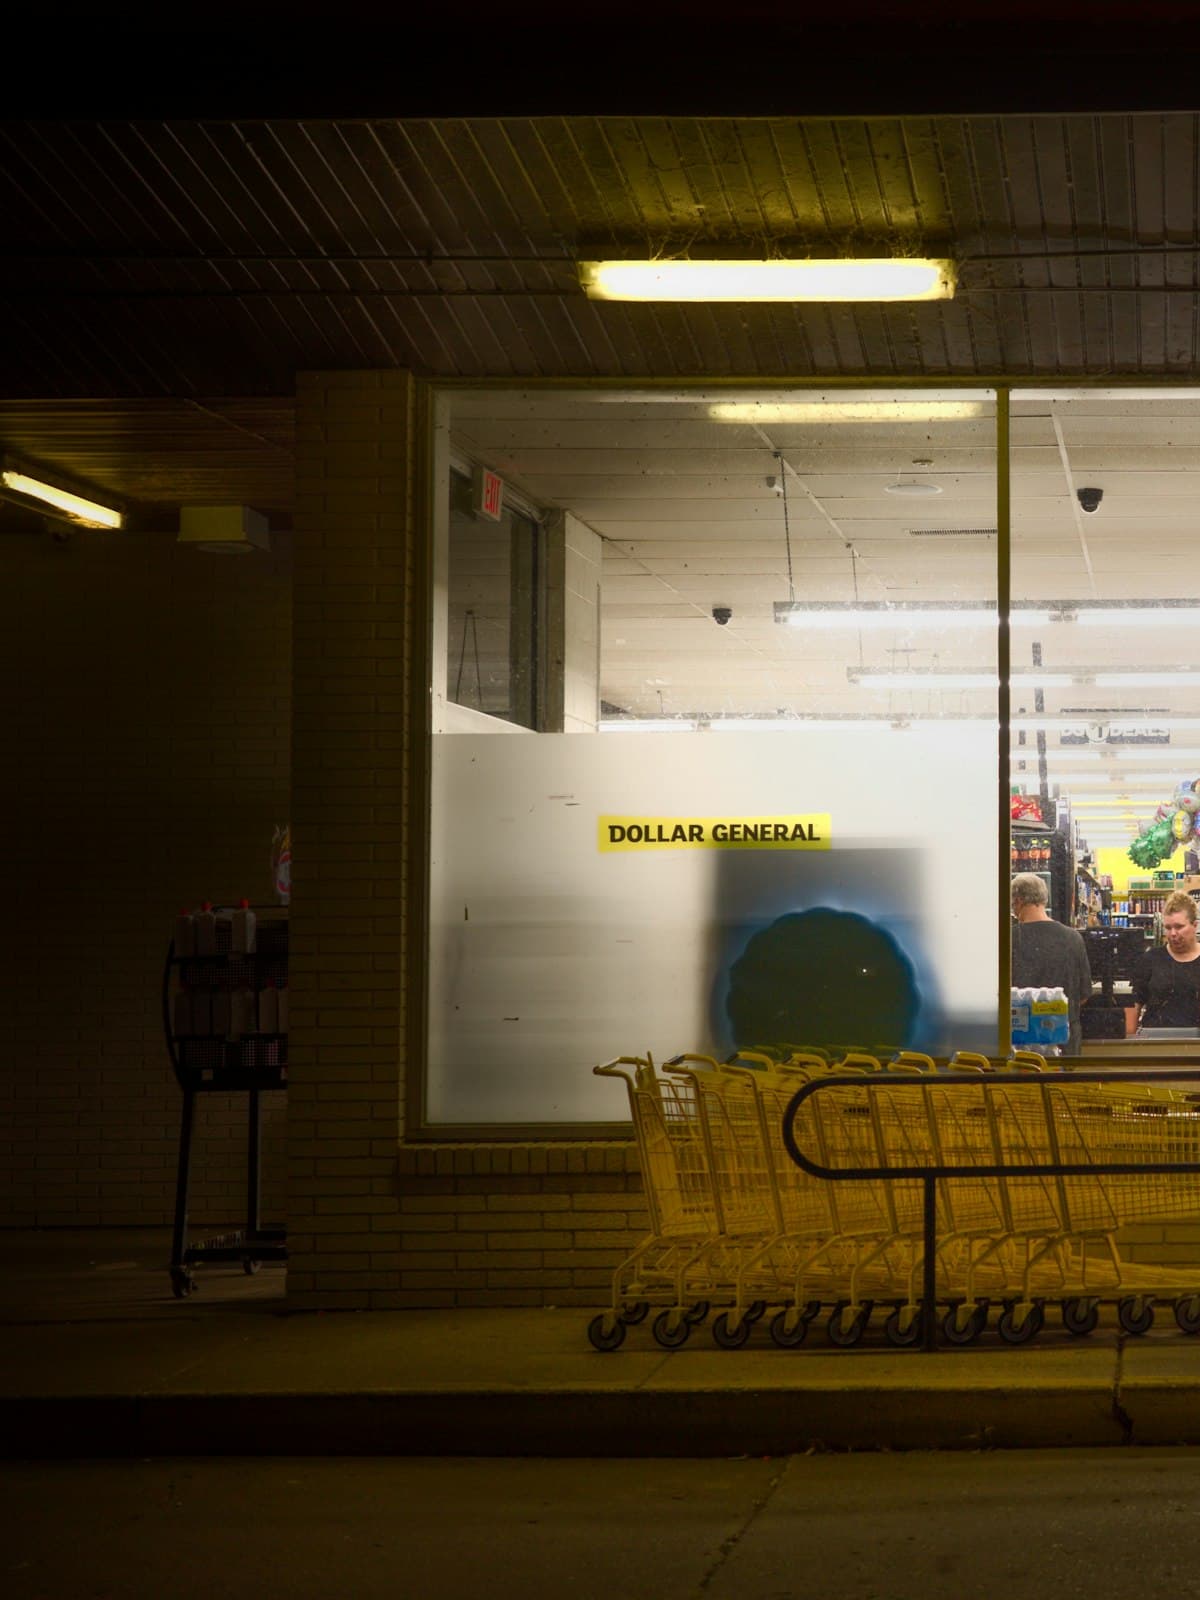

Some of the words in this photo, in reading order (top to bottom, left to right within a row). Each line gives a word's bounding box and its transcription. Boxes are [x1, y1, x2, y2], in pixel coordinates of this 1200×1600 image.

[484, 472, 501, 517] EXIT
[608, 824, 704, 843] DOLLAR
[711, 823, 821, 842] GENERAL
